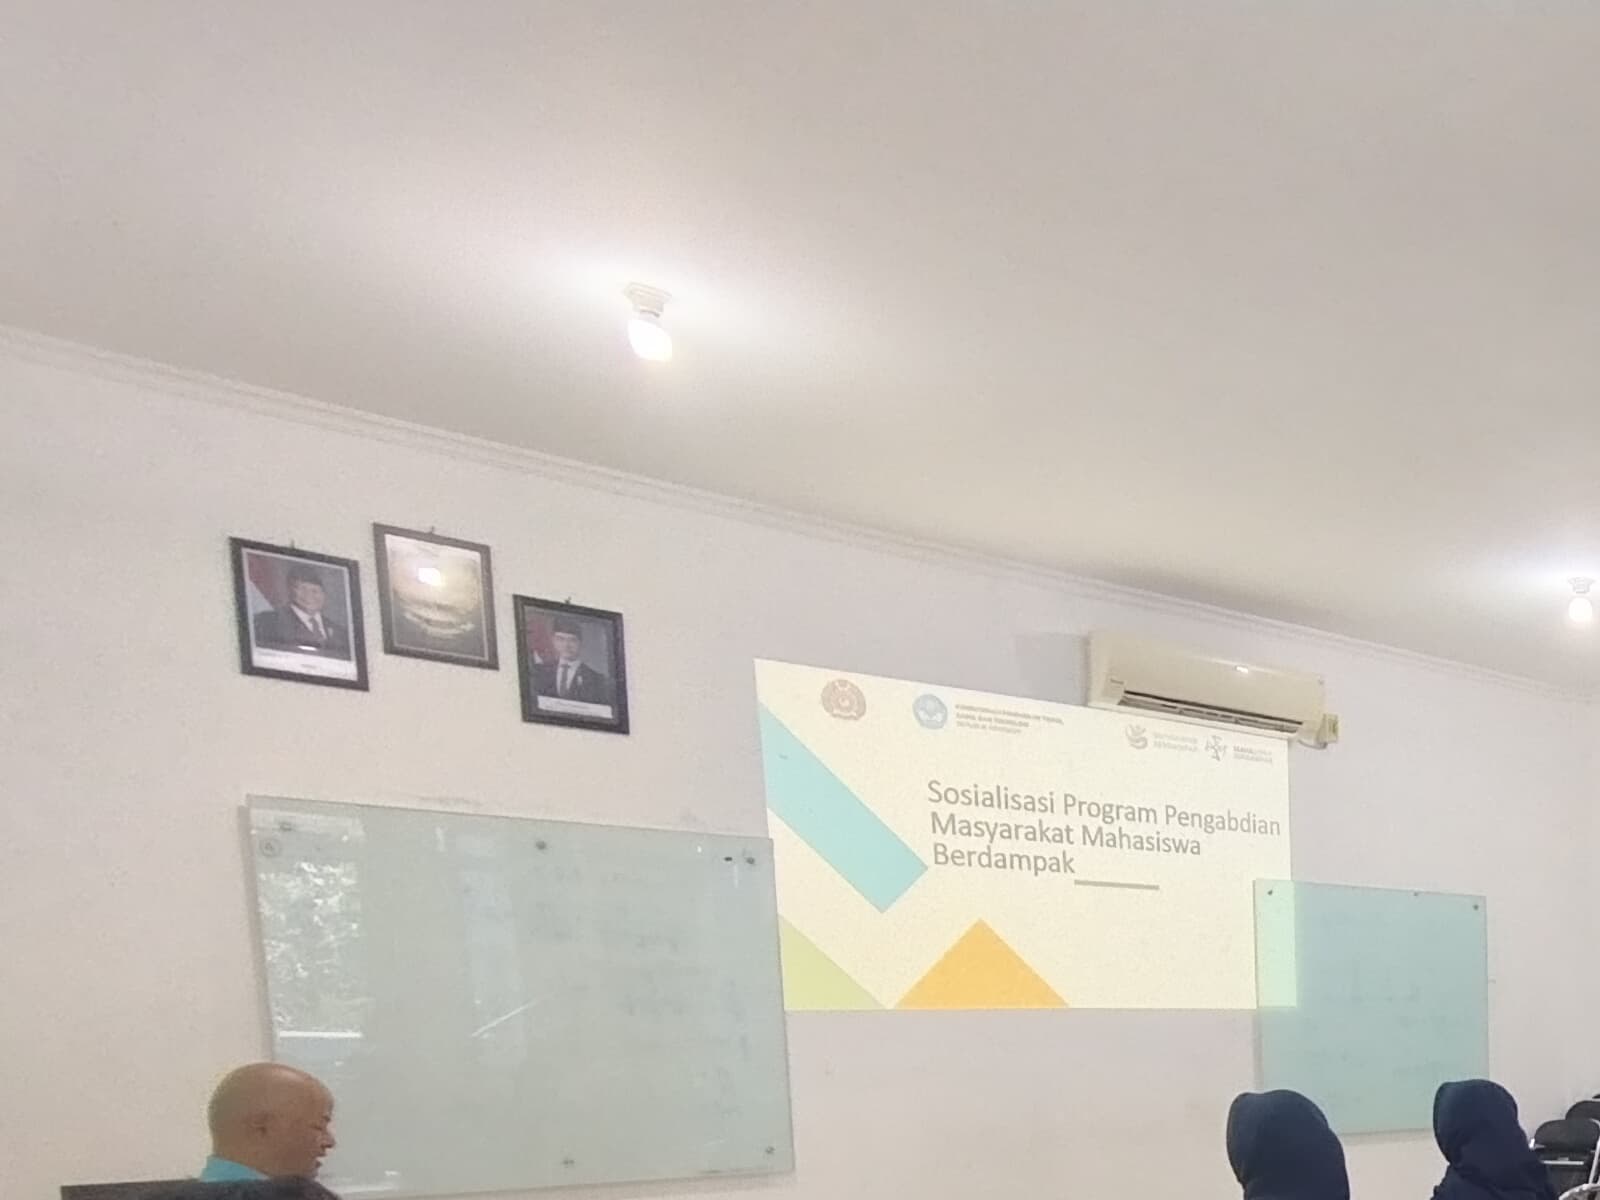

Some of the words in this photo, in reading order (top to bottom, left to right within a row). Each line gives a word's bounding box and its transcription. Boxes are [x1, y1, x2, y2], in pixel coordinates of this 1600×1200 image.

[927, 779, 1055, 814] Sosialisasi
[1063, 793, 1157, 825] Program
[1165, 804, 1281, 836] Pengabdian
[931, 811, 1075, 844] Masyarakat
[1082, 824, 1201, 855] Mahasiswa
[934, 842, 1075, 877] Berdampak
